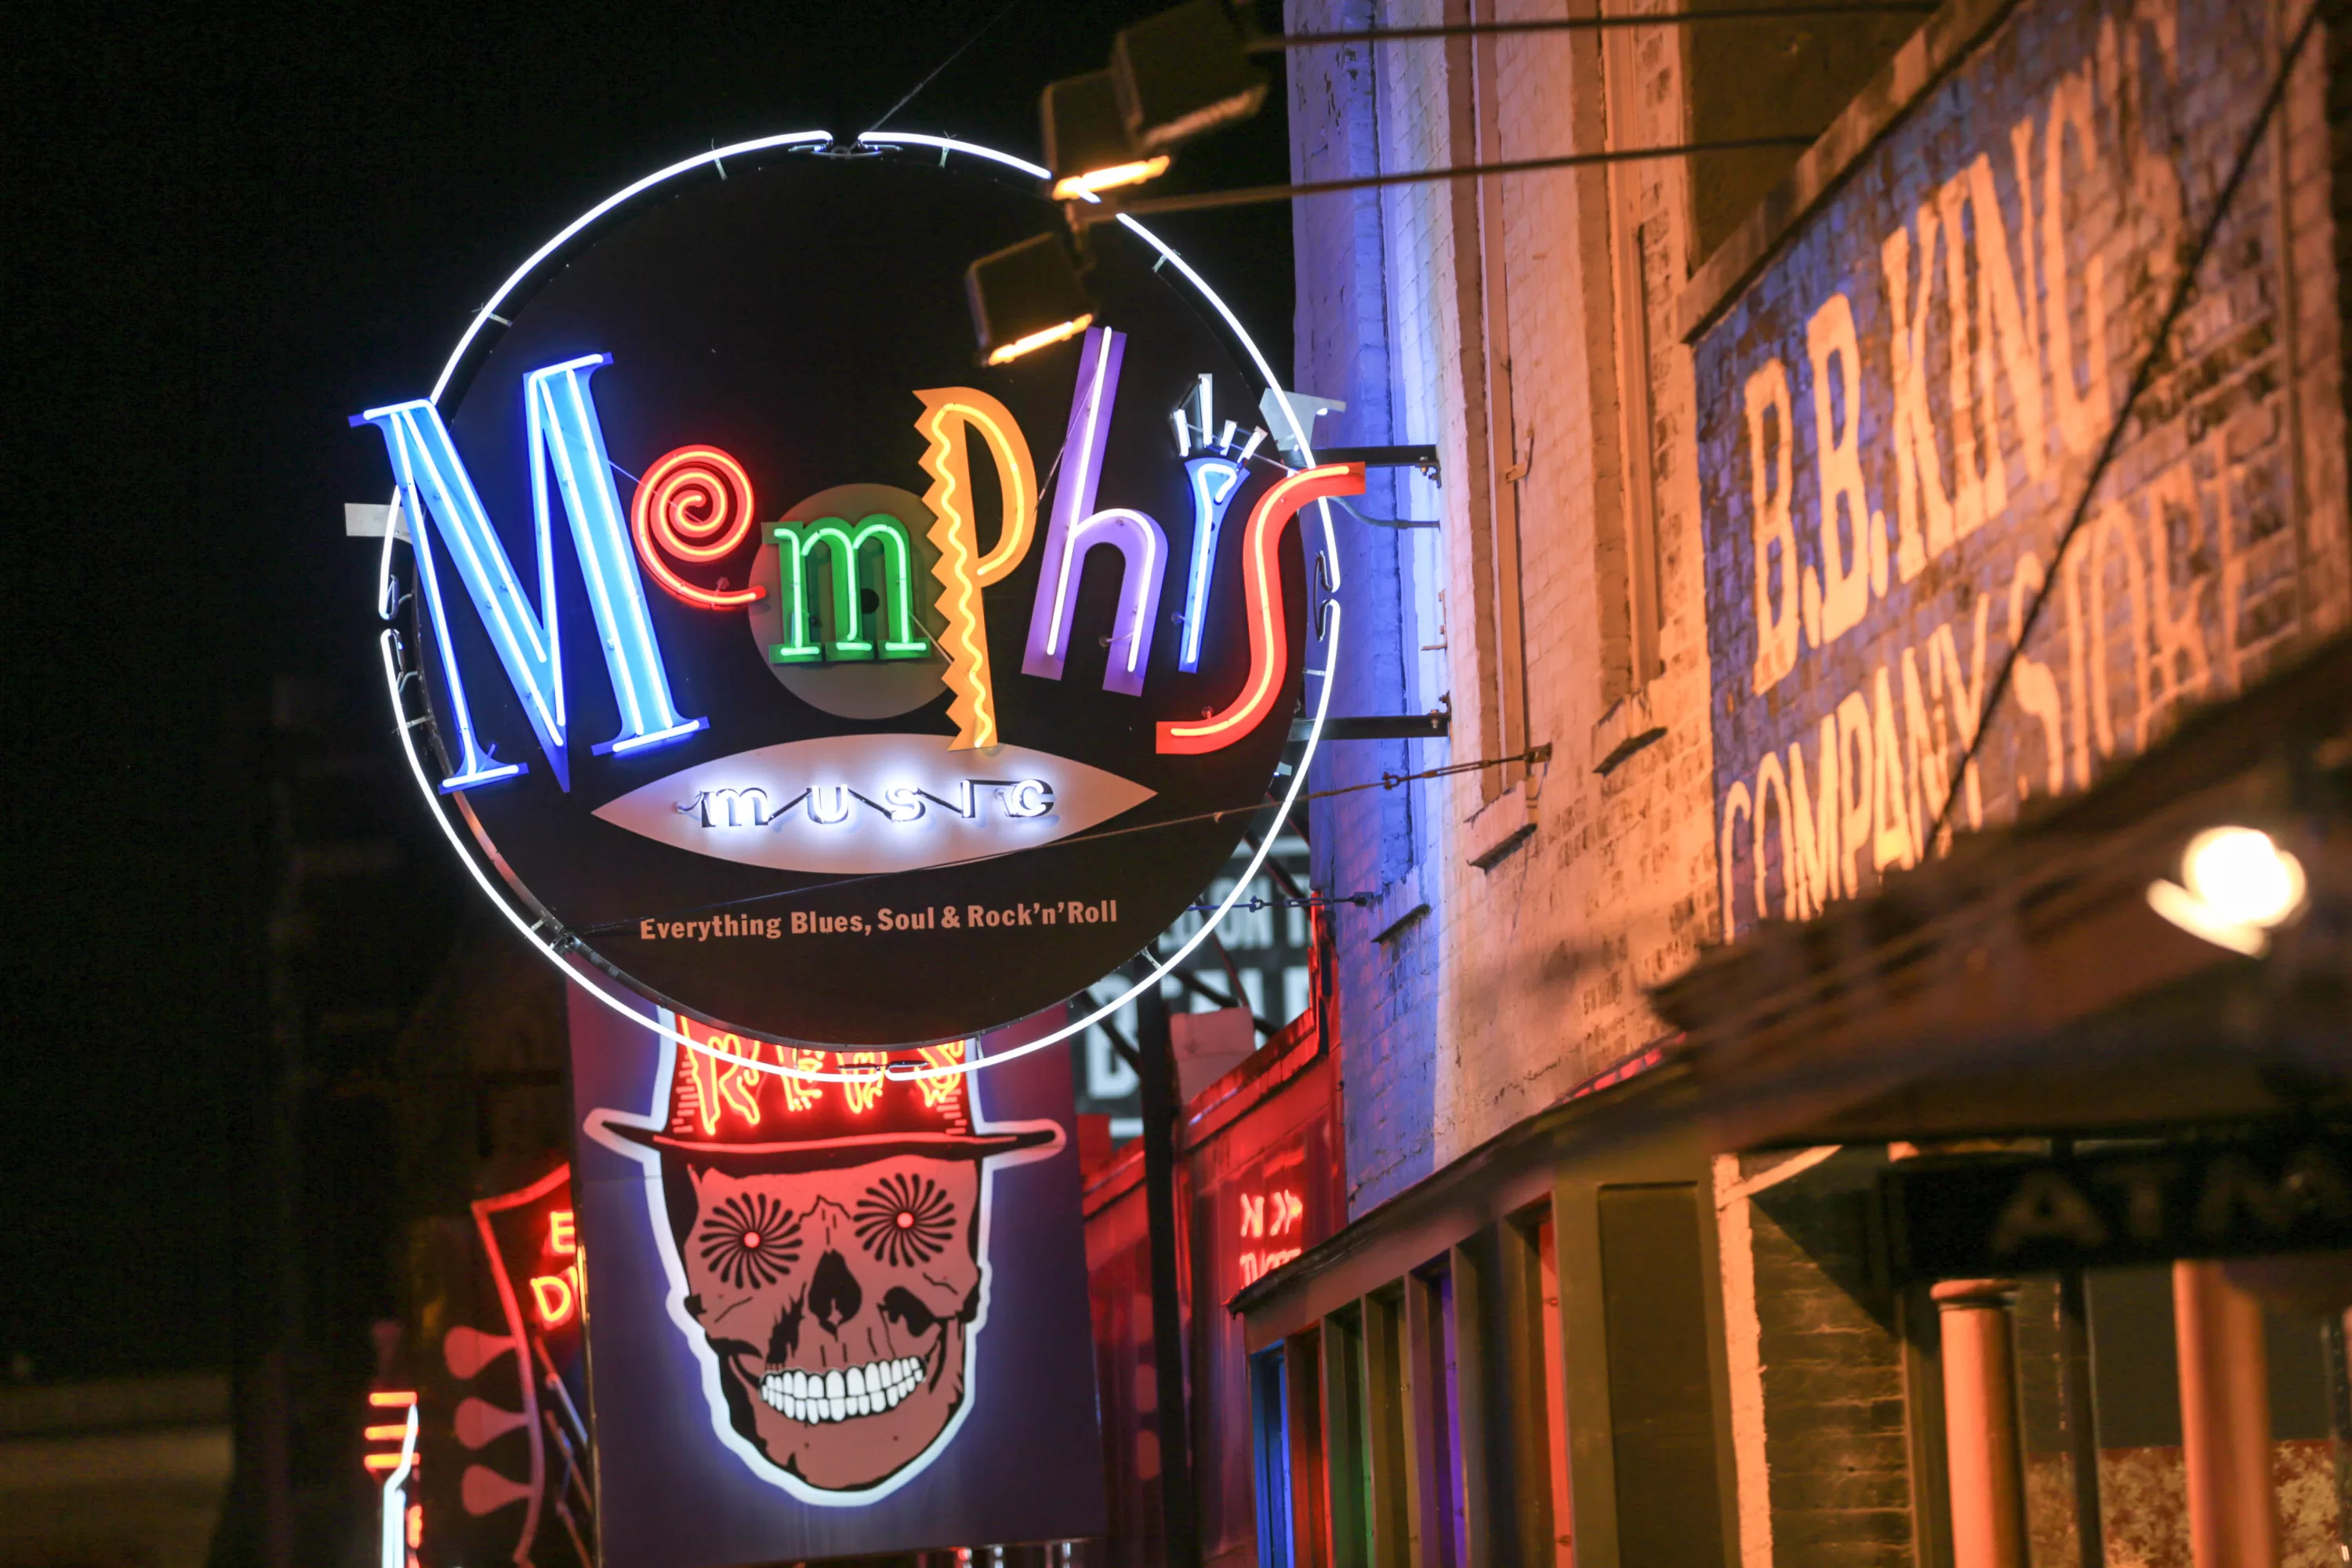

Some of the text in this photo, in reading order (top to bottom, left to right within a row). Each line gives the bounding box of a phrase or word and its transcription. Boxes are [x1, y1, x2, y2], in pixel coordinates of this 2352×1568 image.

[1720, 593, 1990, 944] COMPANY
[641, 913, 782, 942] Everything
[791, 910, 872, 936] Blues,
[877, 907, 935, 931] Soul
[941, 906, 960, 928] &
